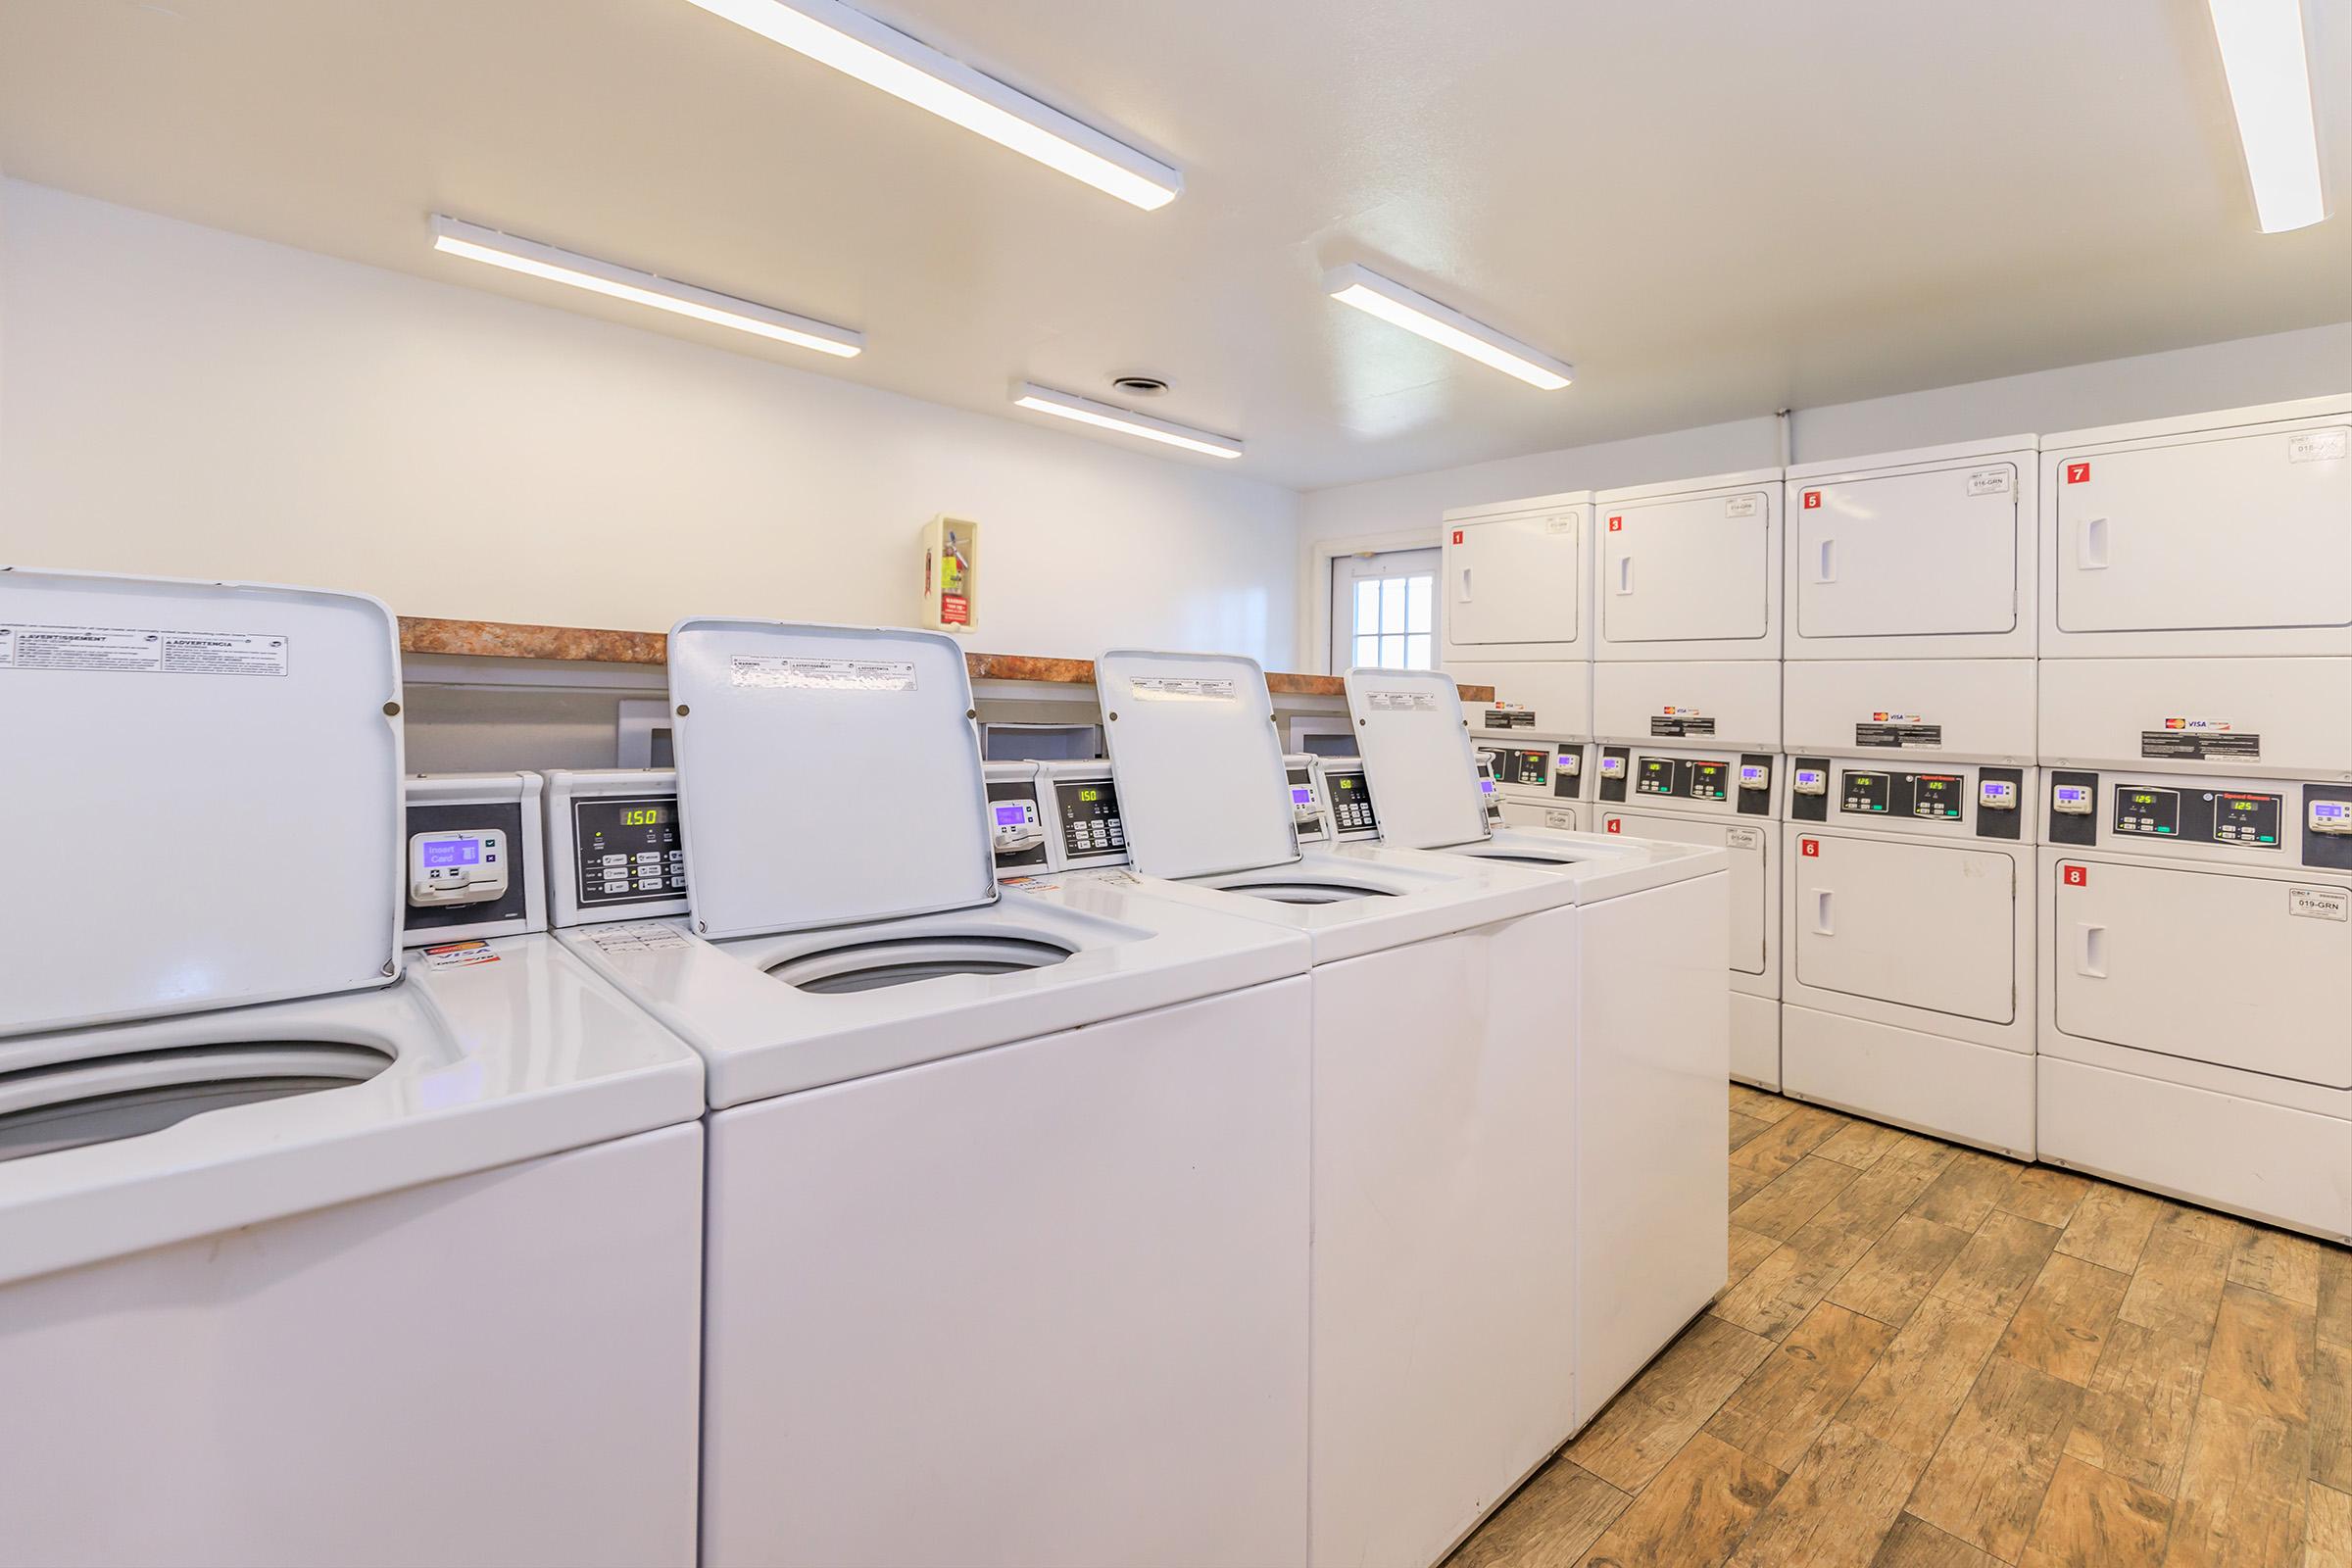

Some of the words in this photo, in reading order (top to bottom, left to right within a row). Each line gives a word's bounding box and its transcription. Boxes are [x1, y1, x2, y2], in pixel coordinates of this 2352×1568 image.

[2073, 468, 2083, 480] 7
[1809, 496, 1817, 507] 5
[1612, 520, 1619, 530] 3
[1455, 534, 1460, 543] 1
[1610, 822, 1617, 832] 4
[1806, 844, 1815, 855] 6
[431, 855, 454, 863] Card
[2071, 871, 2081, 883] 8
[2298, 900, 2339, 909] 019-GRN
[435, 948, 491, 958] VISA
